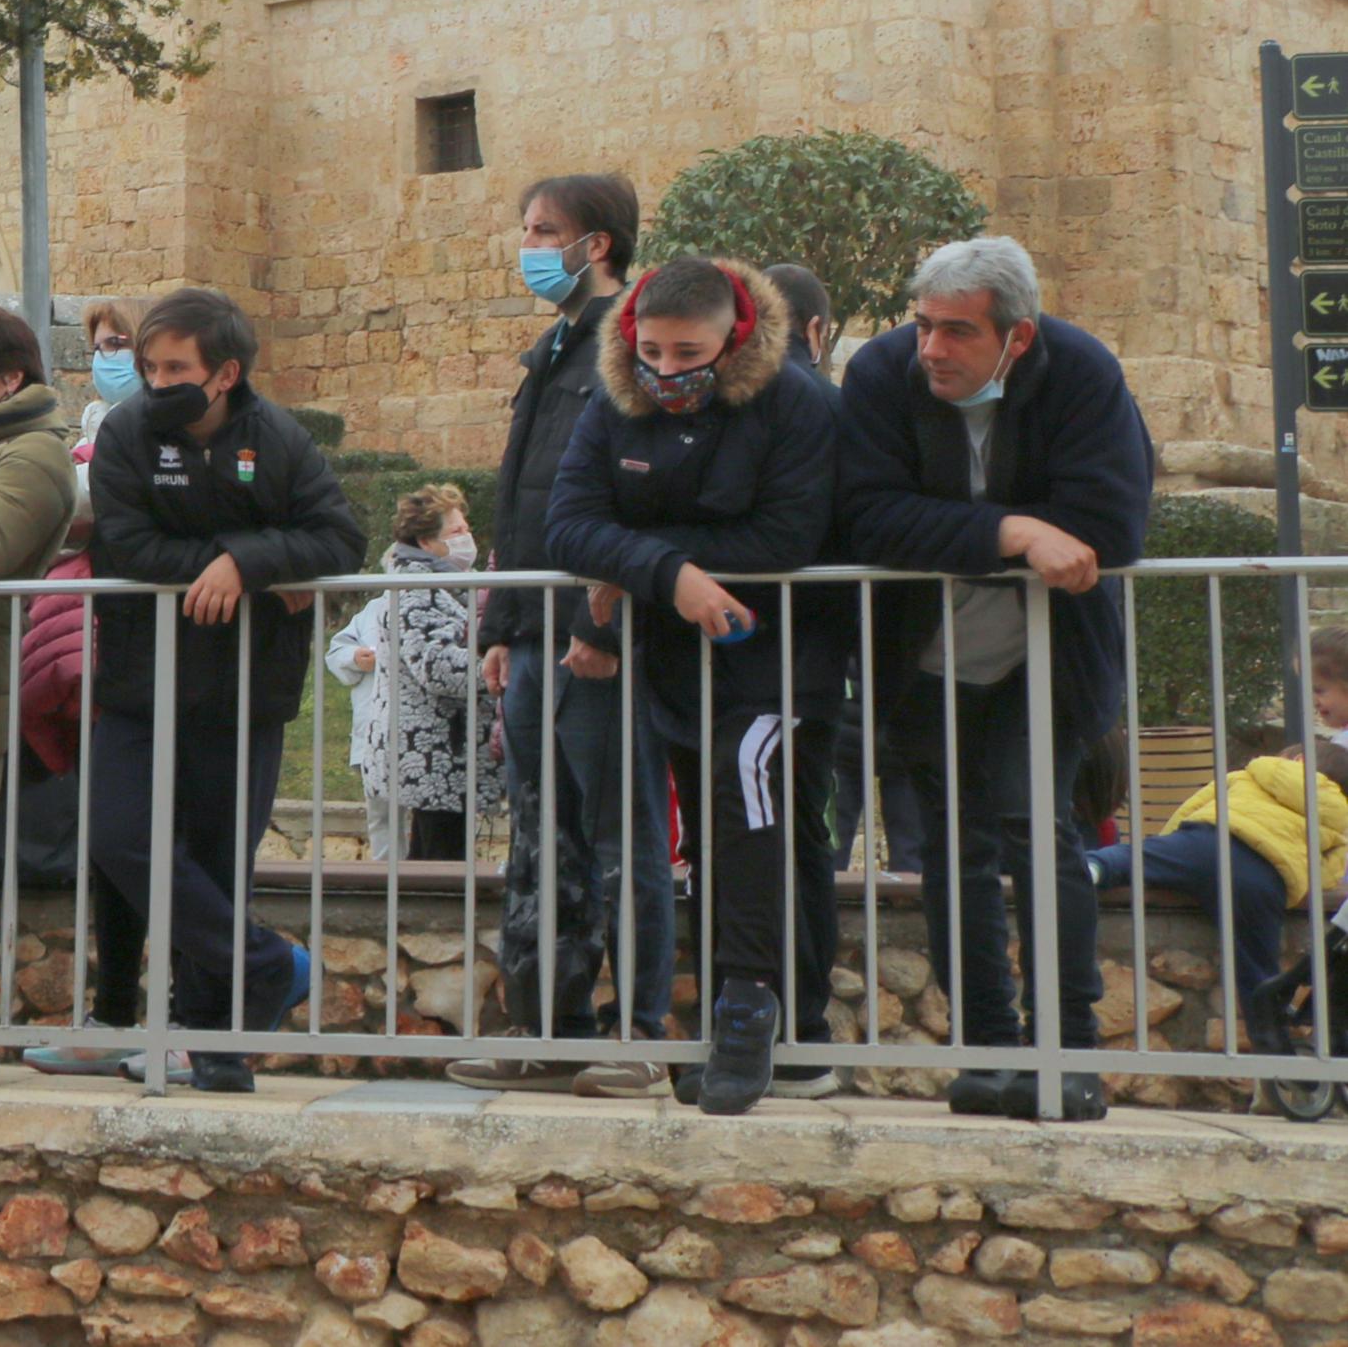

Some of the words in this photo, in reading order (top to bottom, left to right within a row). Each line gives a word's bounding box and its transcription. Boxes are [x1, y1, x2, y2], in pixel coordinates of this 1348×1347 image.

[1303, 131, 1341, 144] Canal
[1305, 204, 1340, 217] Canal
[1306, 219, 1337, 231] Soto
